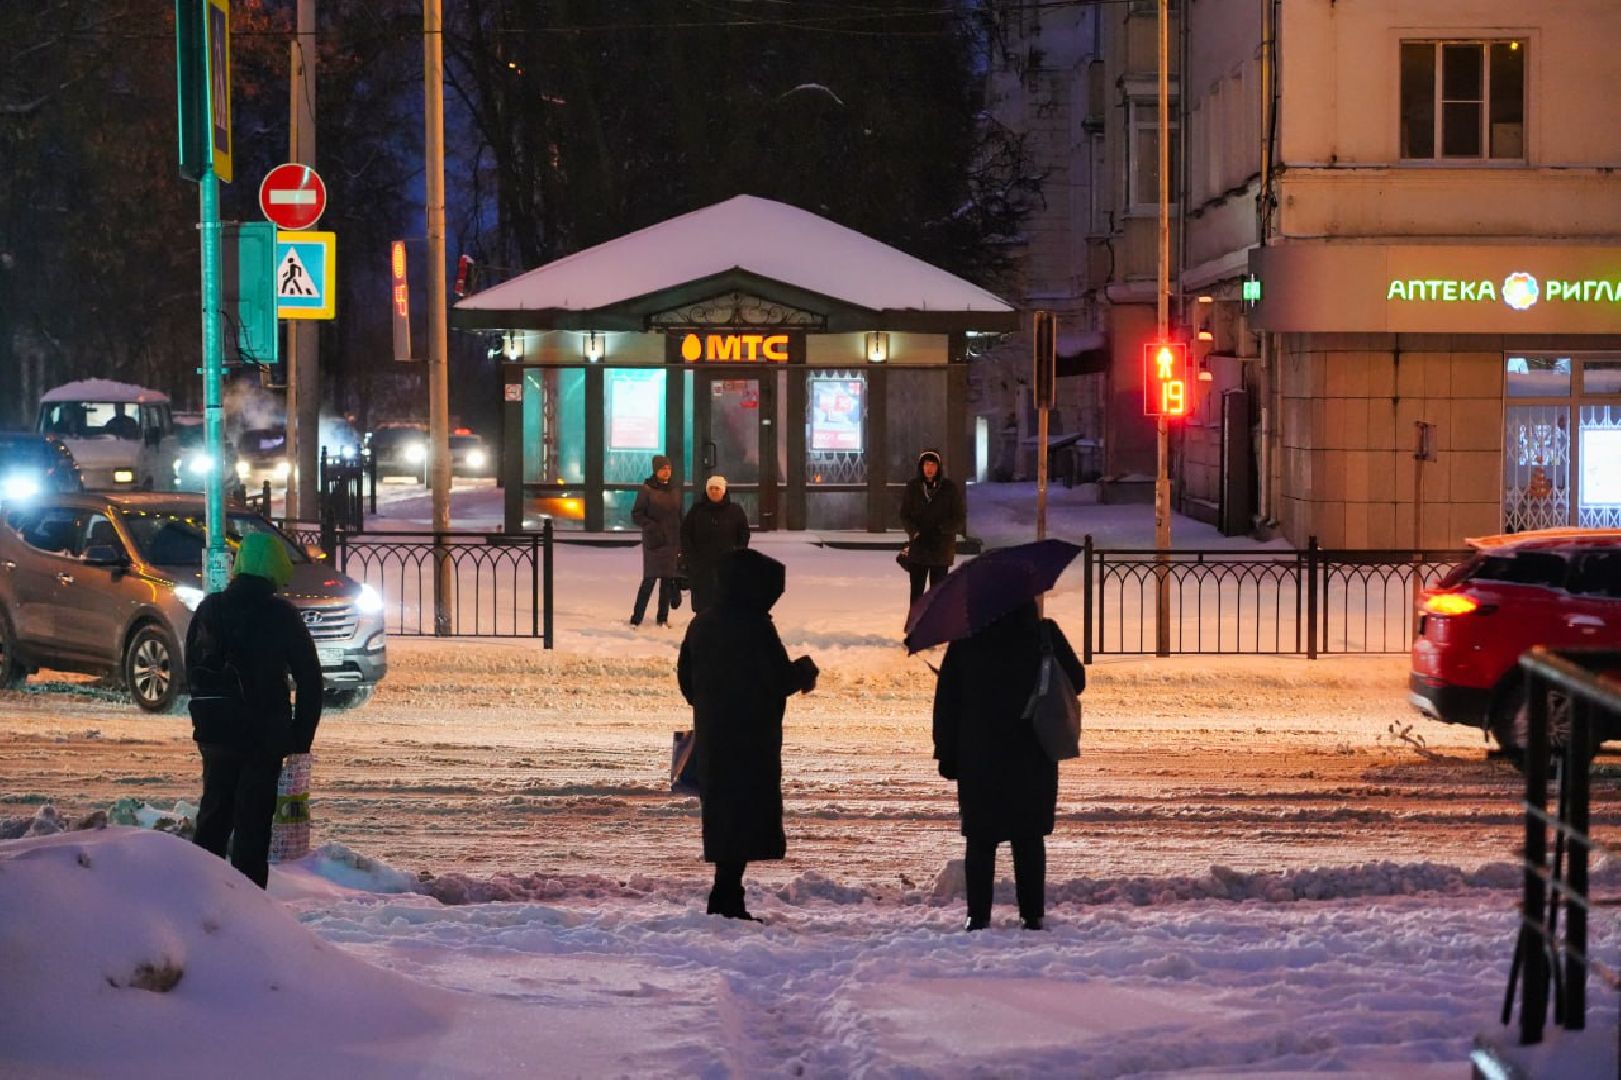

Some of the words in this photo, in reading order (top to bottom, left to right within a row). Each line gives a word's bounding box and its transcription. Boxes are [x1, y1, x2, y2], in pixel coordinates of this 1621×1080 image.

[1387, 280, 1496, 301] АПТЕКА
[706, 334, 789, 360] МТС
[1162, 381, 1184, 414] 19
